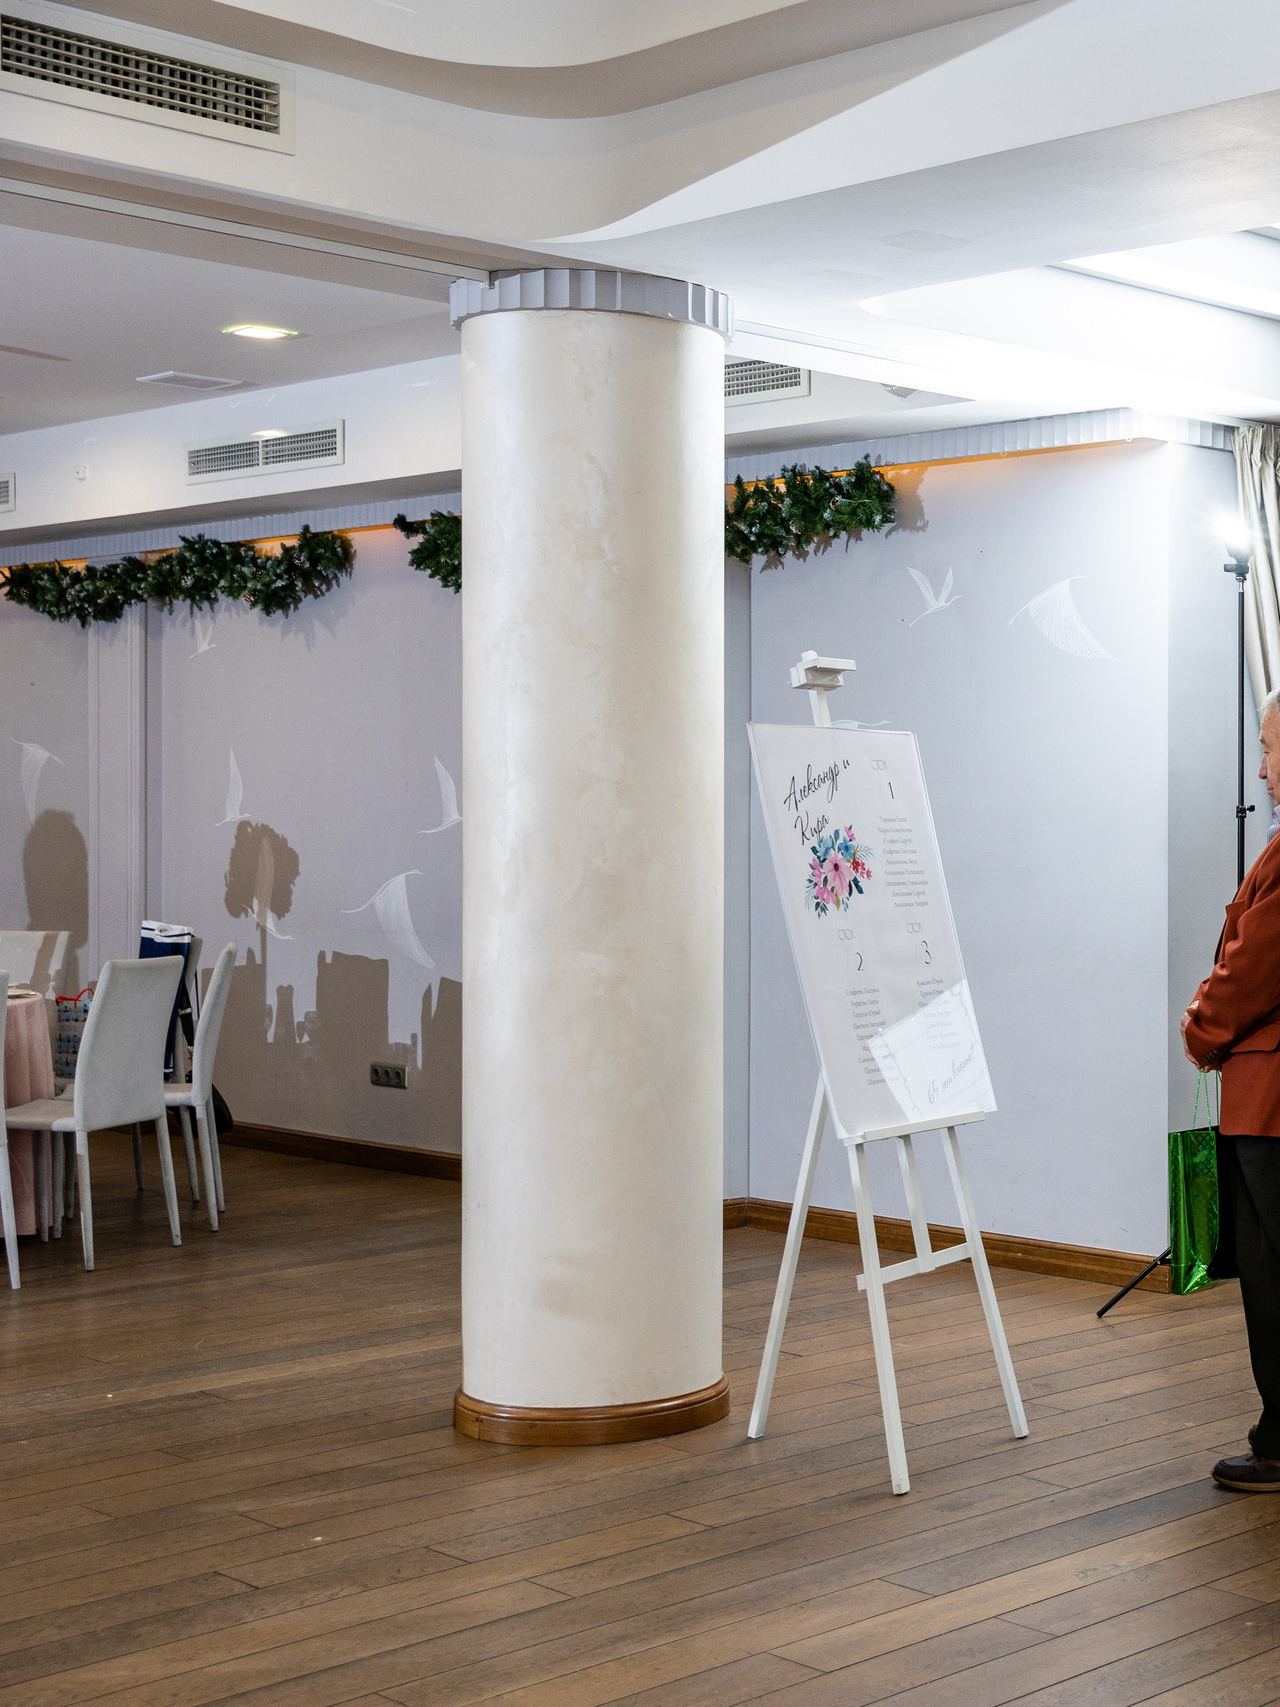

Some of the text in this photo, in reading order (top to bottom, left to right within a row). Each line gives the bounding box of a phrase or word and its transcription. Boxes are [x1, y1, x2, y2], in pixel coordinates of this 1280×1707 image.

[783, 759, 851, 812] Александр и
[794, 811, 830, 846] Кира
[855, 952, 865, 972] 2
[920, 940, 932, 965] 3
